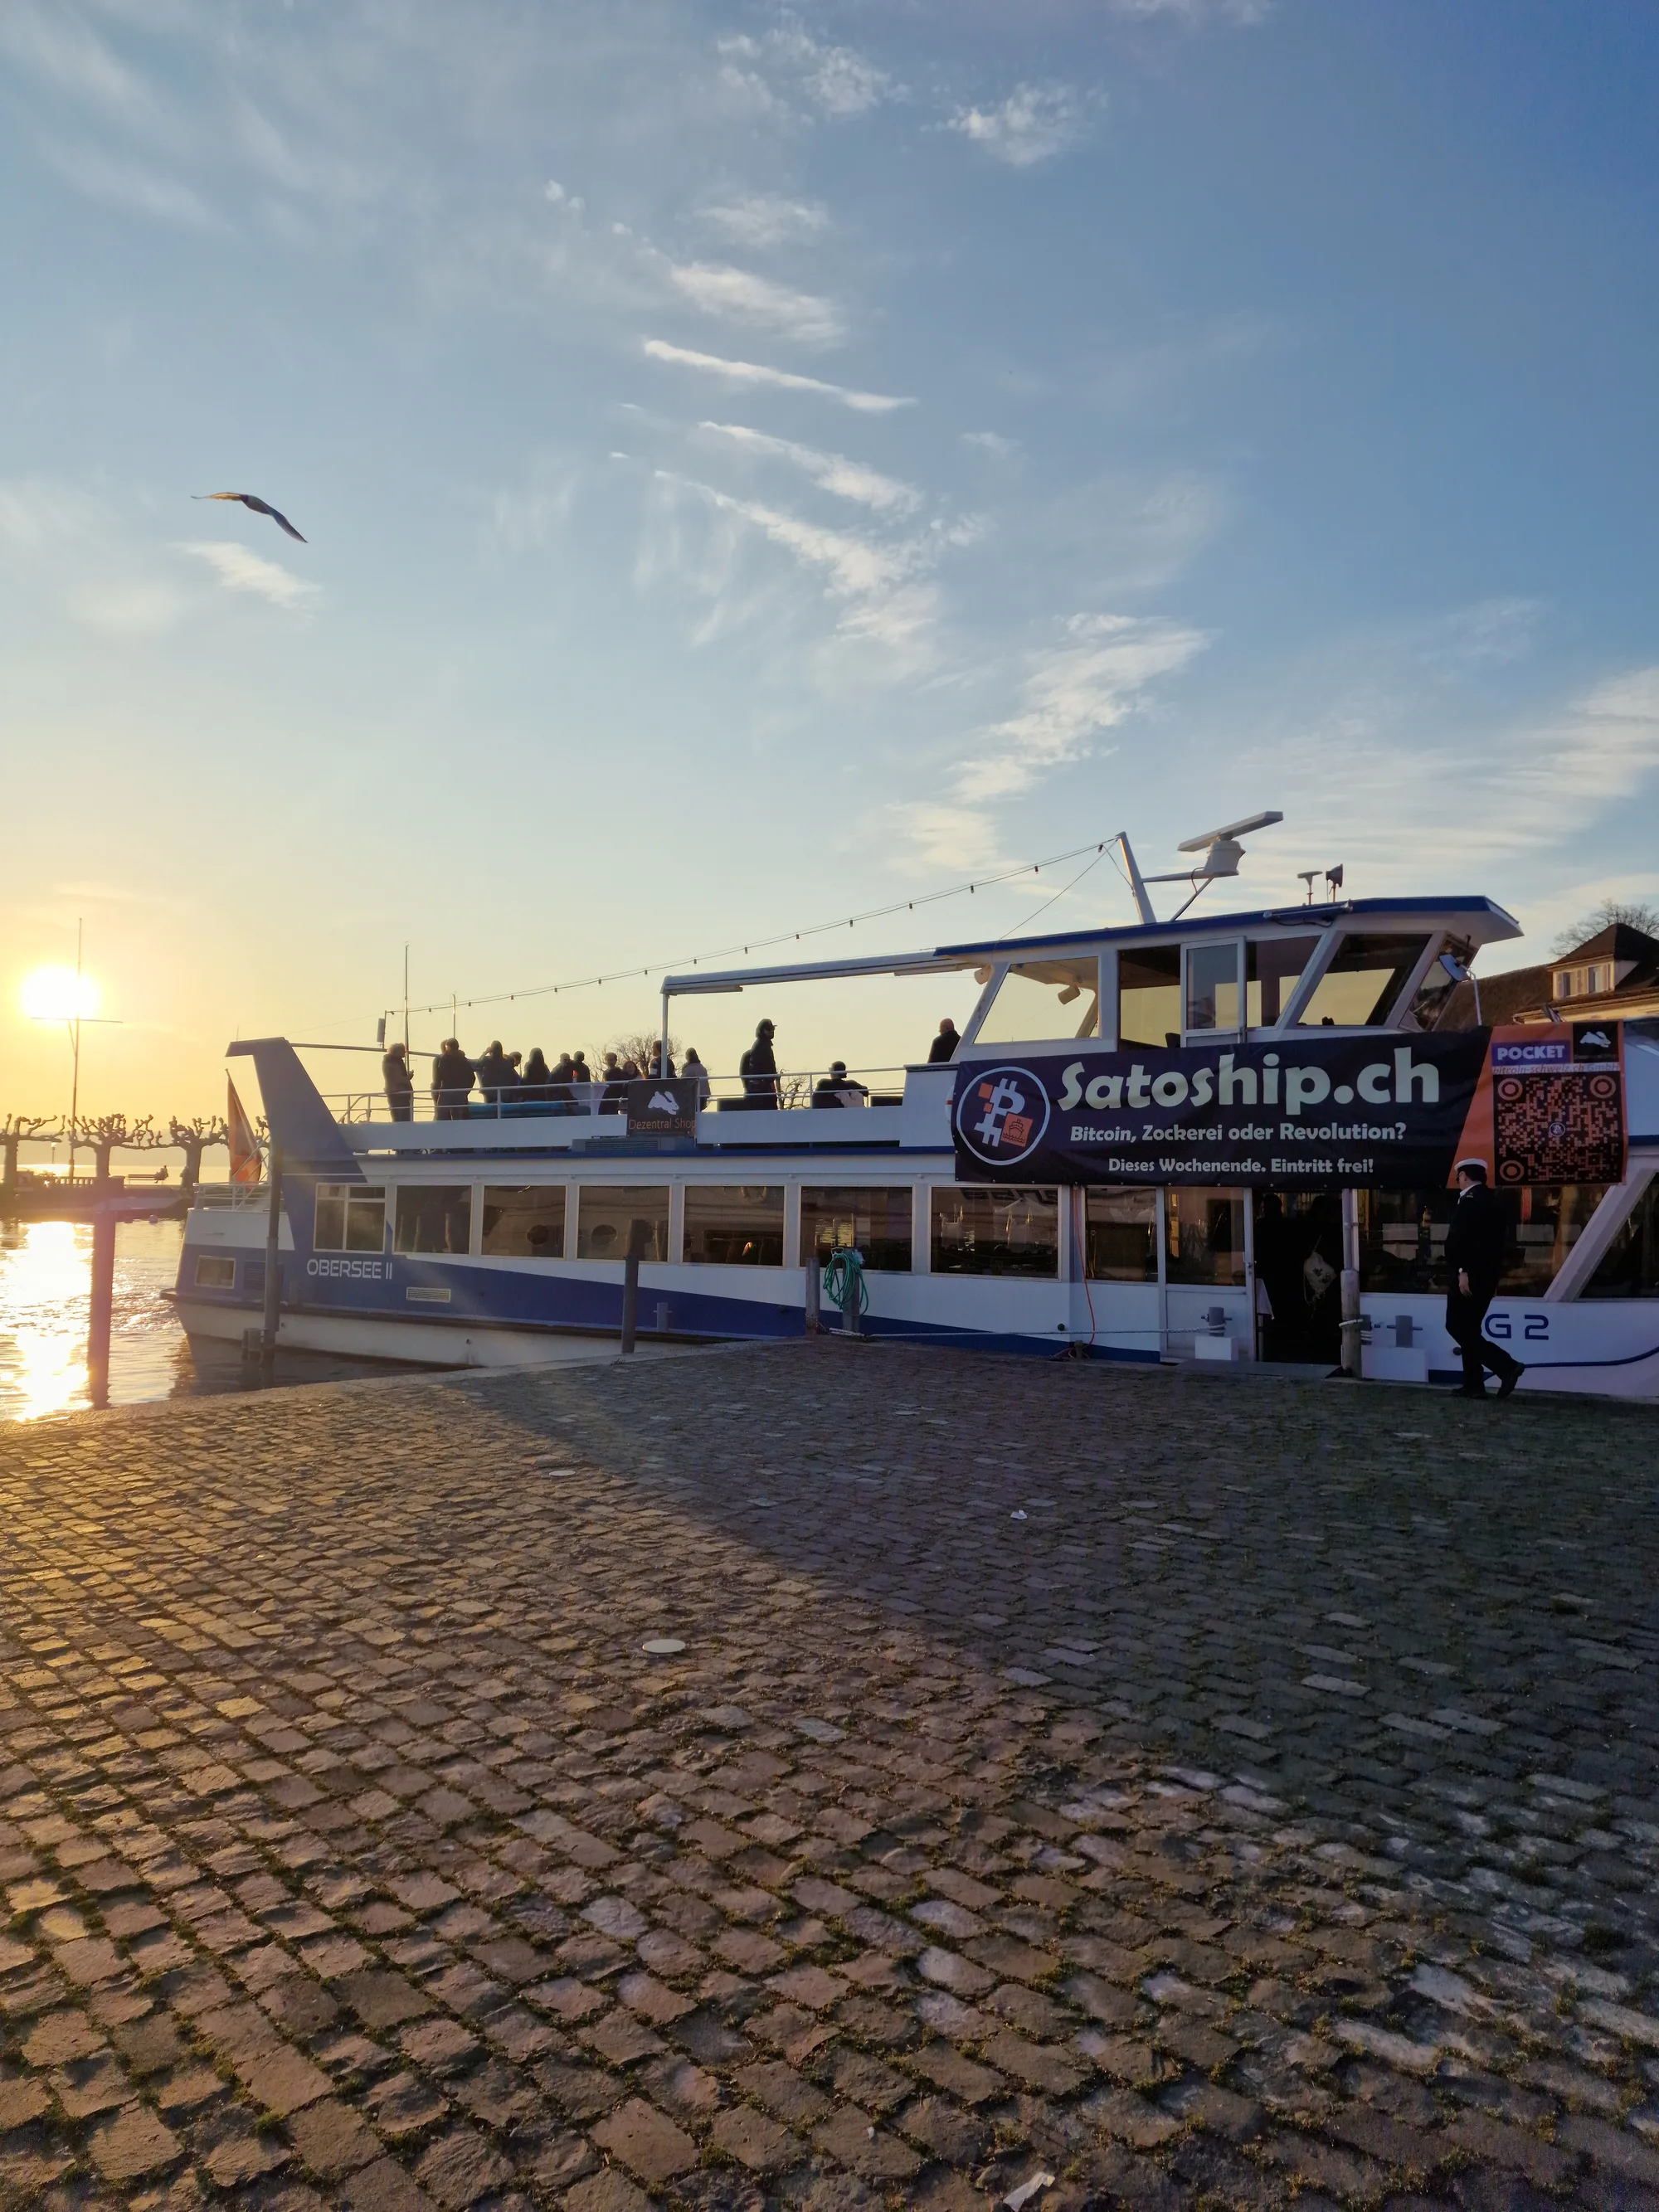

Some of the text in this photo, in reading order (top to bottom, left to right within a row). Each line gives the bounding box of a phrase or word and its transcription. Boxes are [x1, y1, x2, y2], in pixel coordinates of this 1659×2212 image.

[1497, 1045, 1564, 1060] POCKET
[1058, 1047, 1439, 1115] Satoship.ch
[629, 1117, 696, 1132] Dezentral Shop
[1070, 1122, 1406, 1143] Bitcoin, Zockerei oder Revolution?
[1108, 1158, 1374, 1174] Dieses Wochenende. Eintritt frei!
[306, 1258, 392, 1280] OBERSEE II
